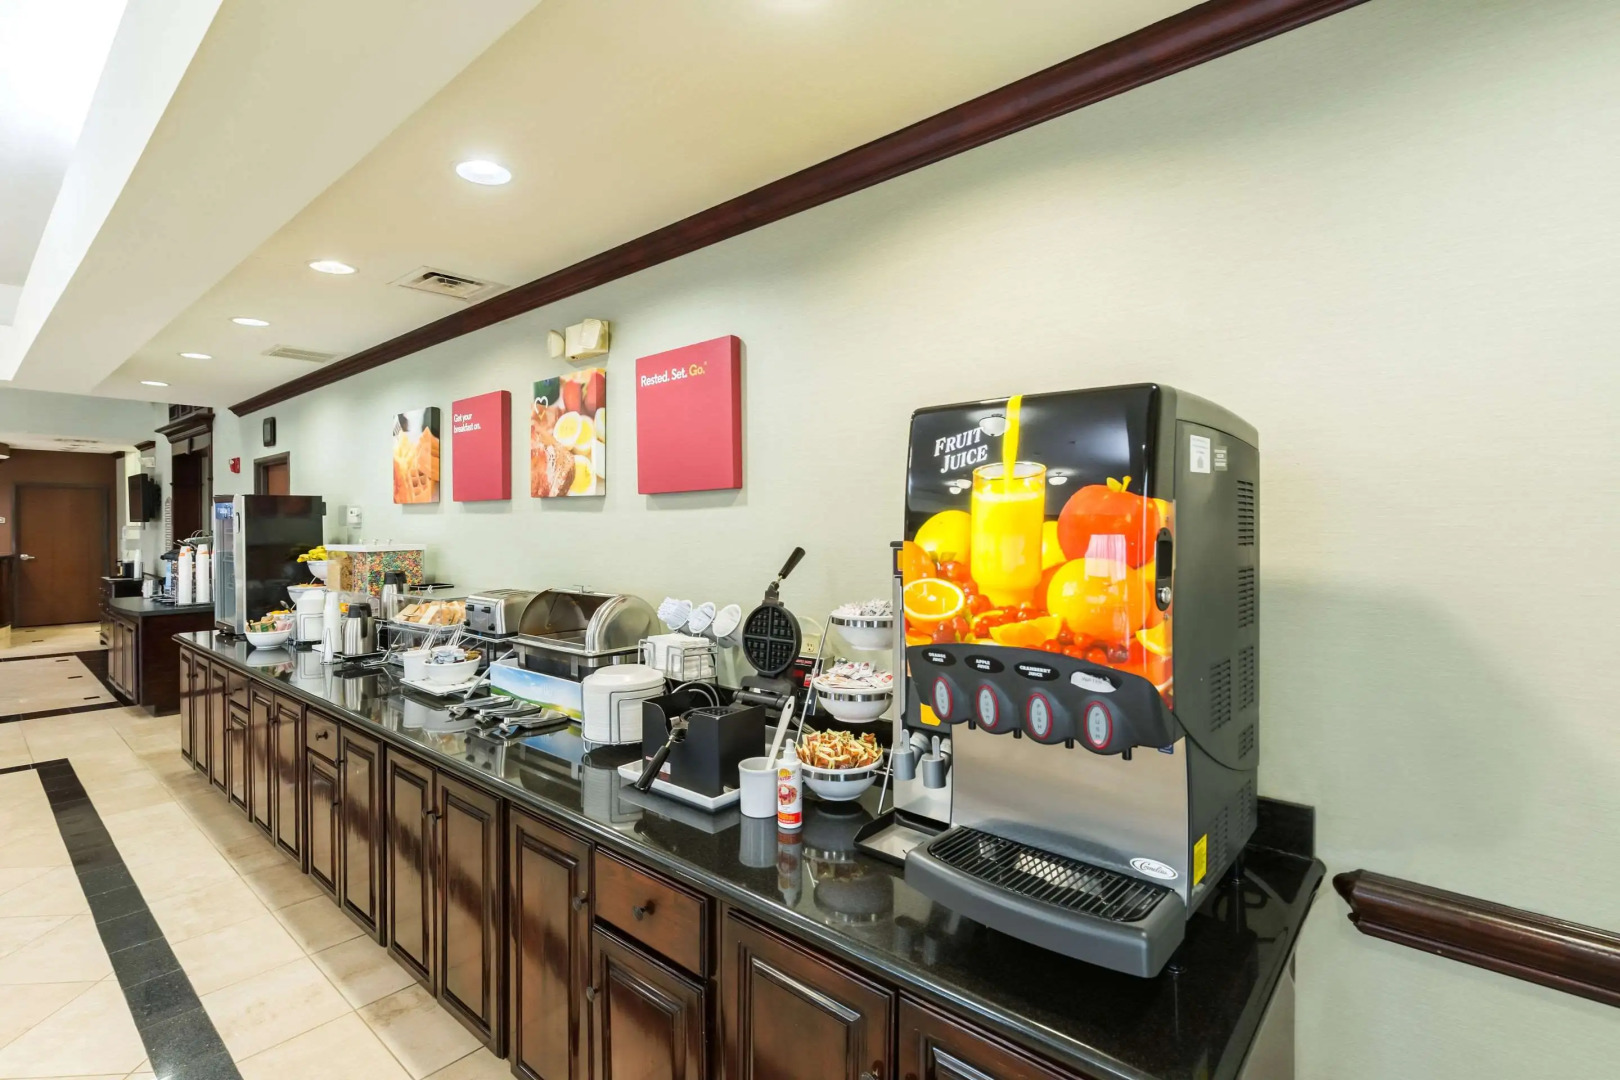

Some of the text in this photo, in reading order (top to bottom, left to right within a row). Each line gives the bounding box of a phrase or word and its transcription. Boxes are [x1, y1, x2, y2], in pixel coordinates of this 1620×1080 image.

[641, 370, 670, 387] Rested.
[671, 368, 688, 380] Set.
[454, 414, 472, 422] Get your
[454, 423, 473, 433] breakfast
[933, 426, 984, 457] FRUIT
[940, 444, 988, 474] JUICE
[1019, 665, 1051, 673] CRANBERRY
